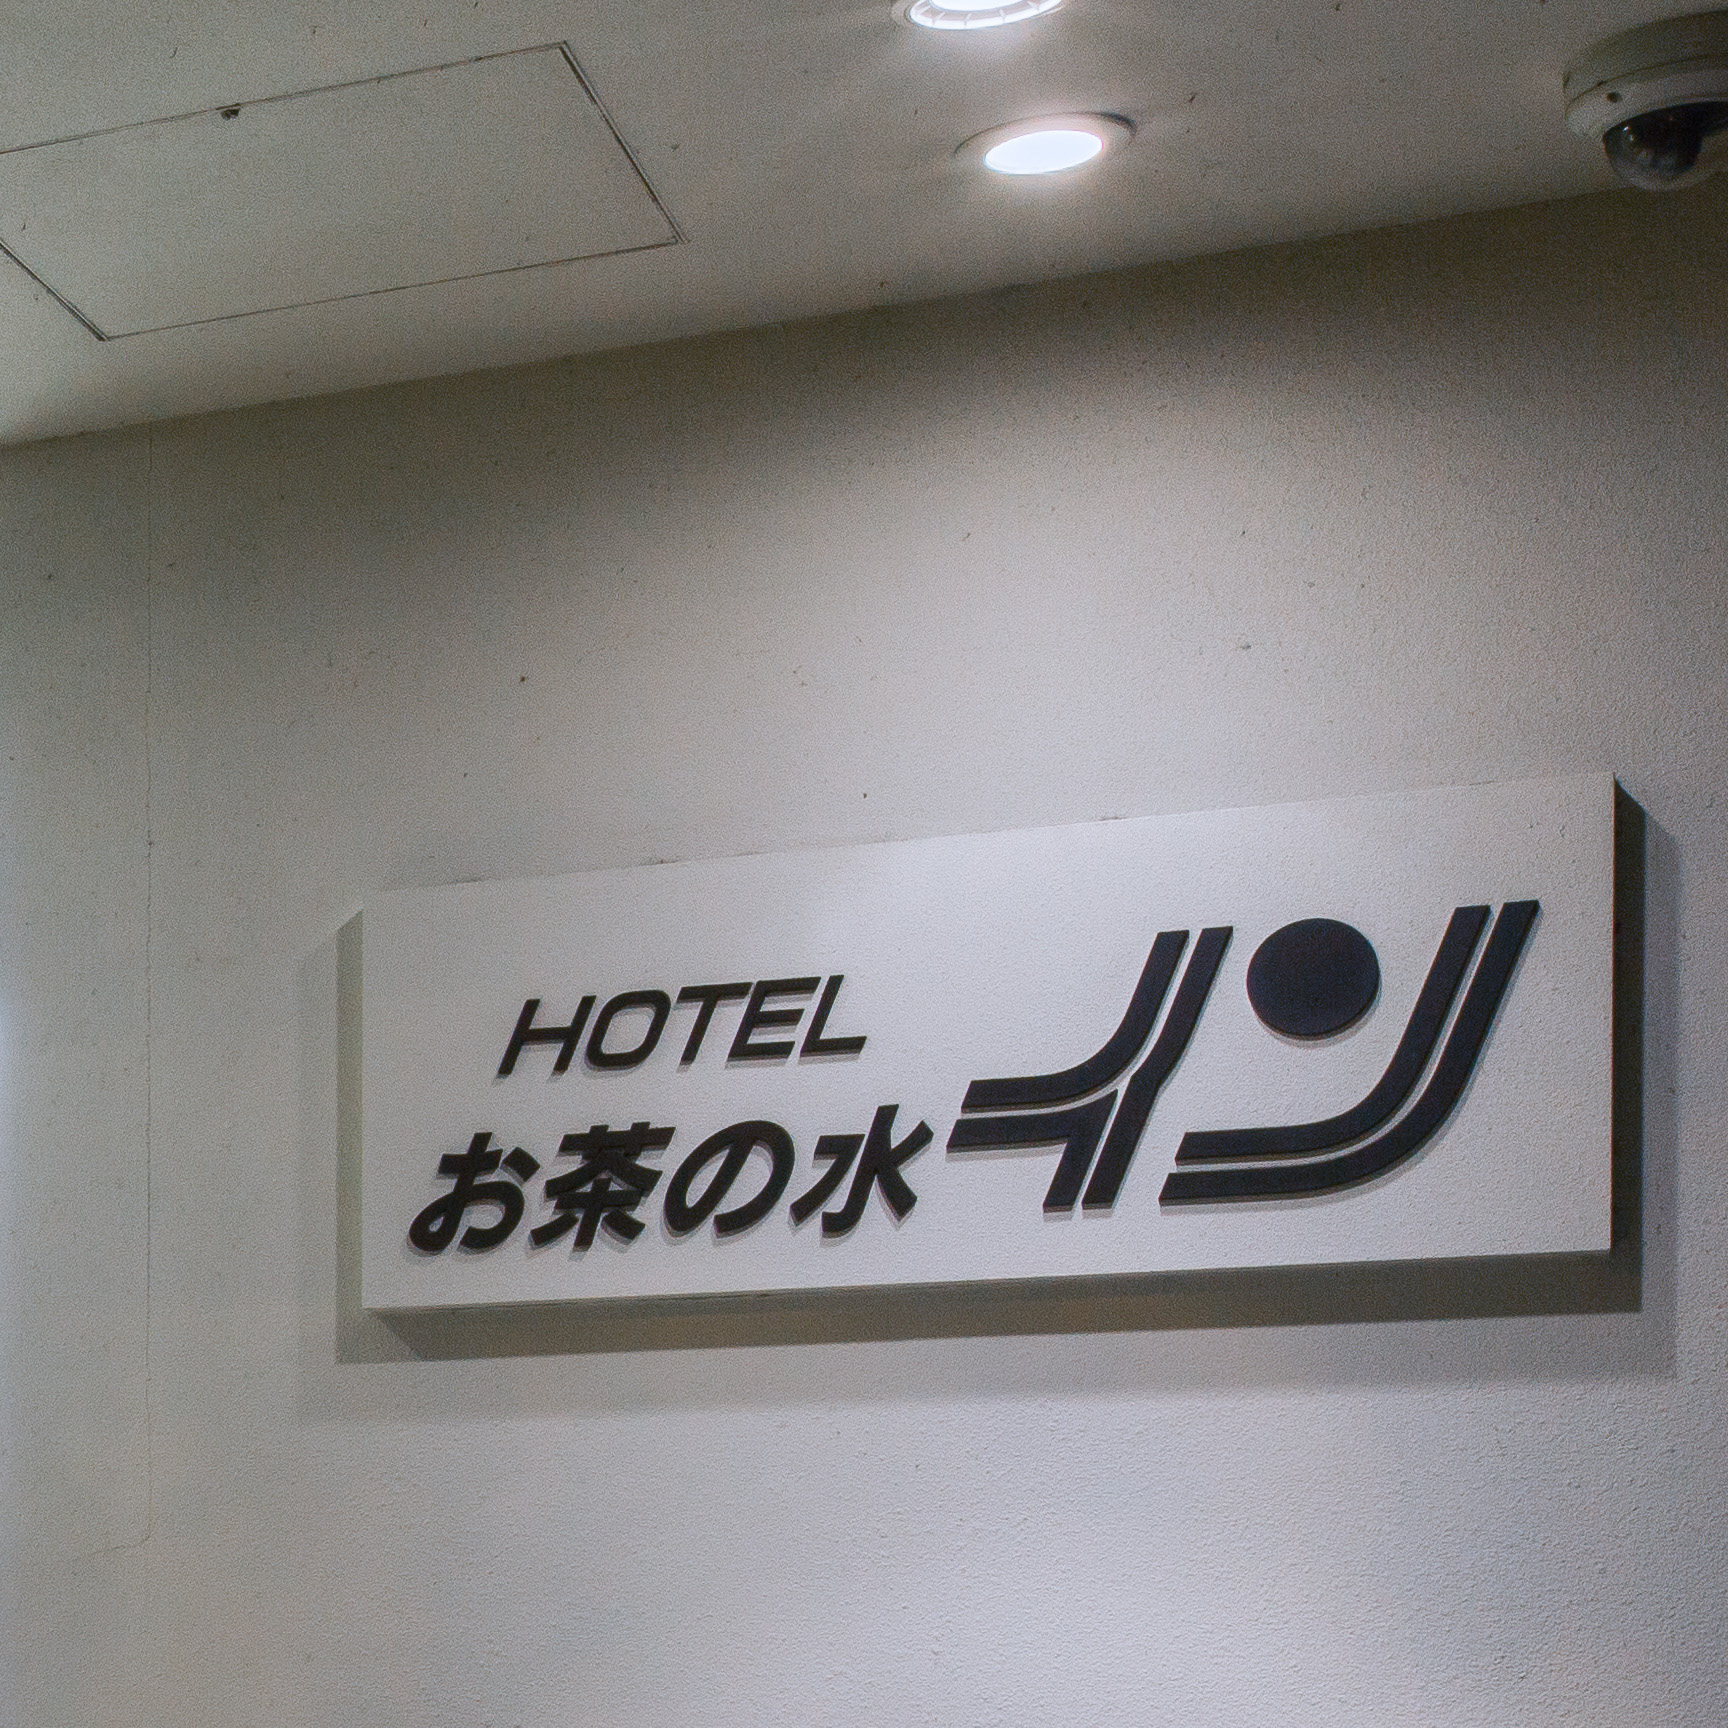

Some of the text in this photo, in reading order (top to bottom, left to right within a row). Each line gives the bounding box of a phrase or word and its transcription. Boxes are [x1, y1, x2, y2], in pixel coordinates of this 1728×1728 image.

[498, 974, 867, 1078] HOTEL
[408, 1104, 933, 1255] お茶の水
